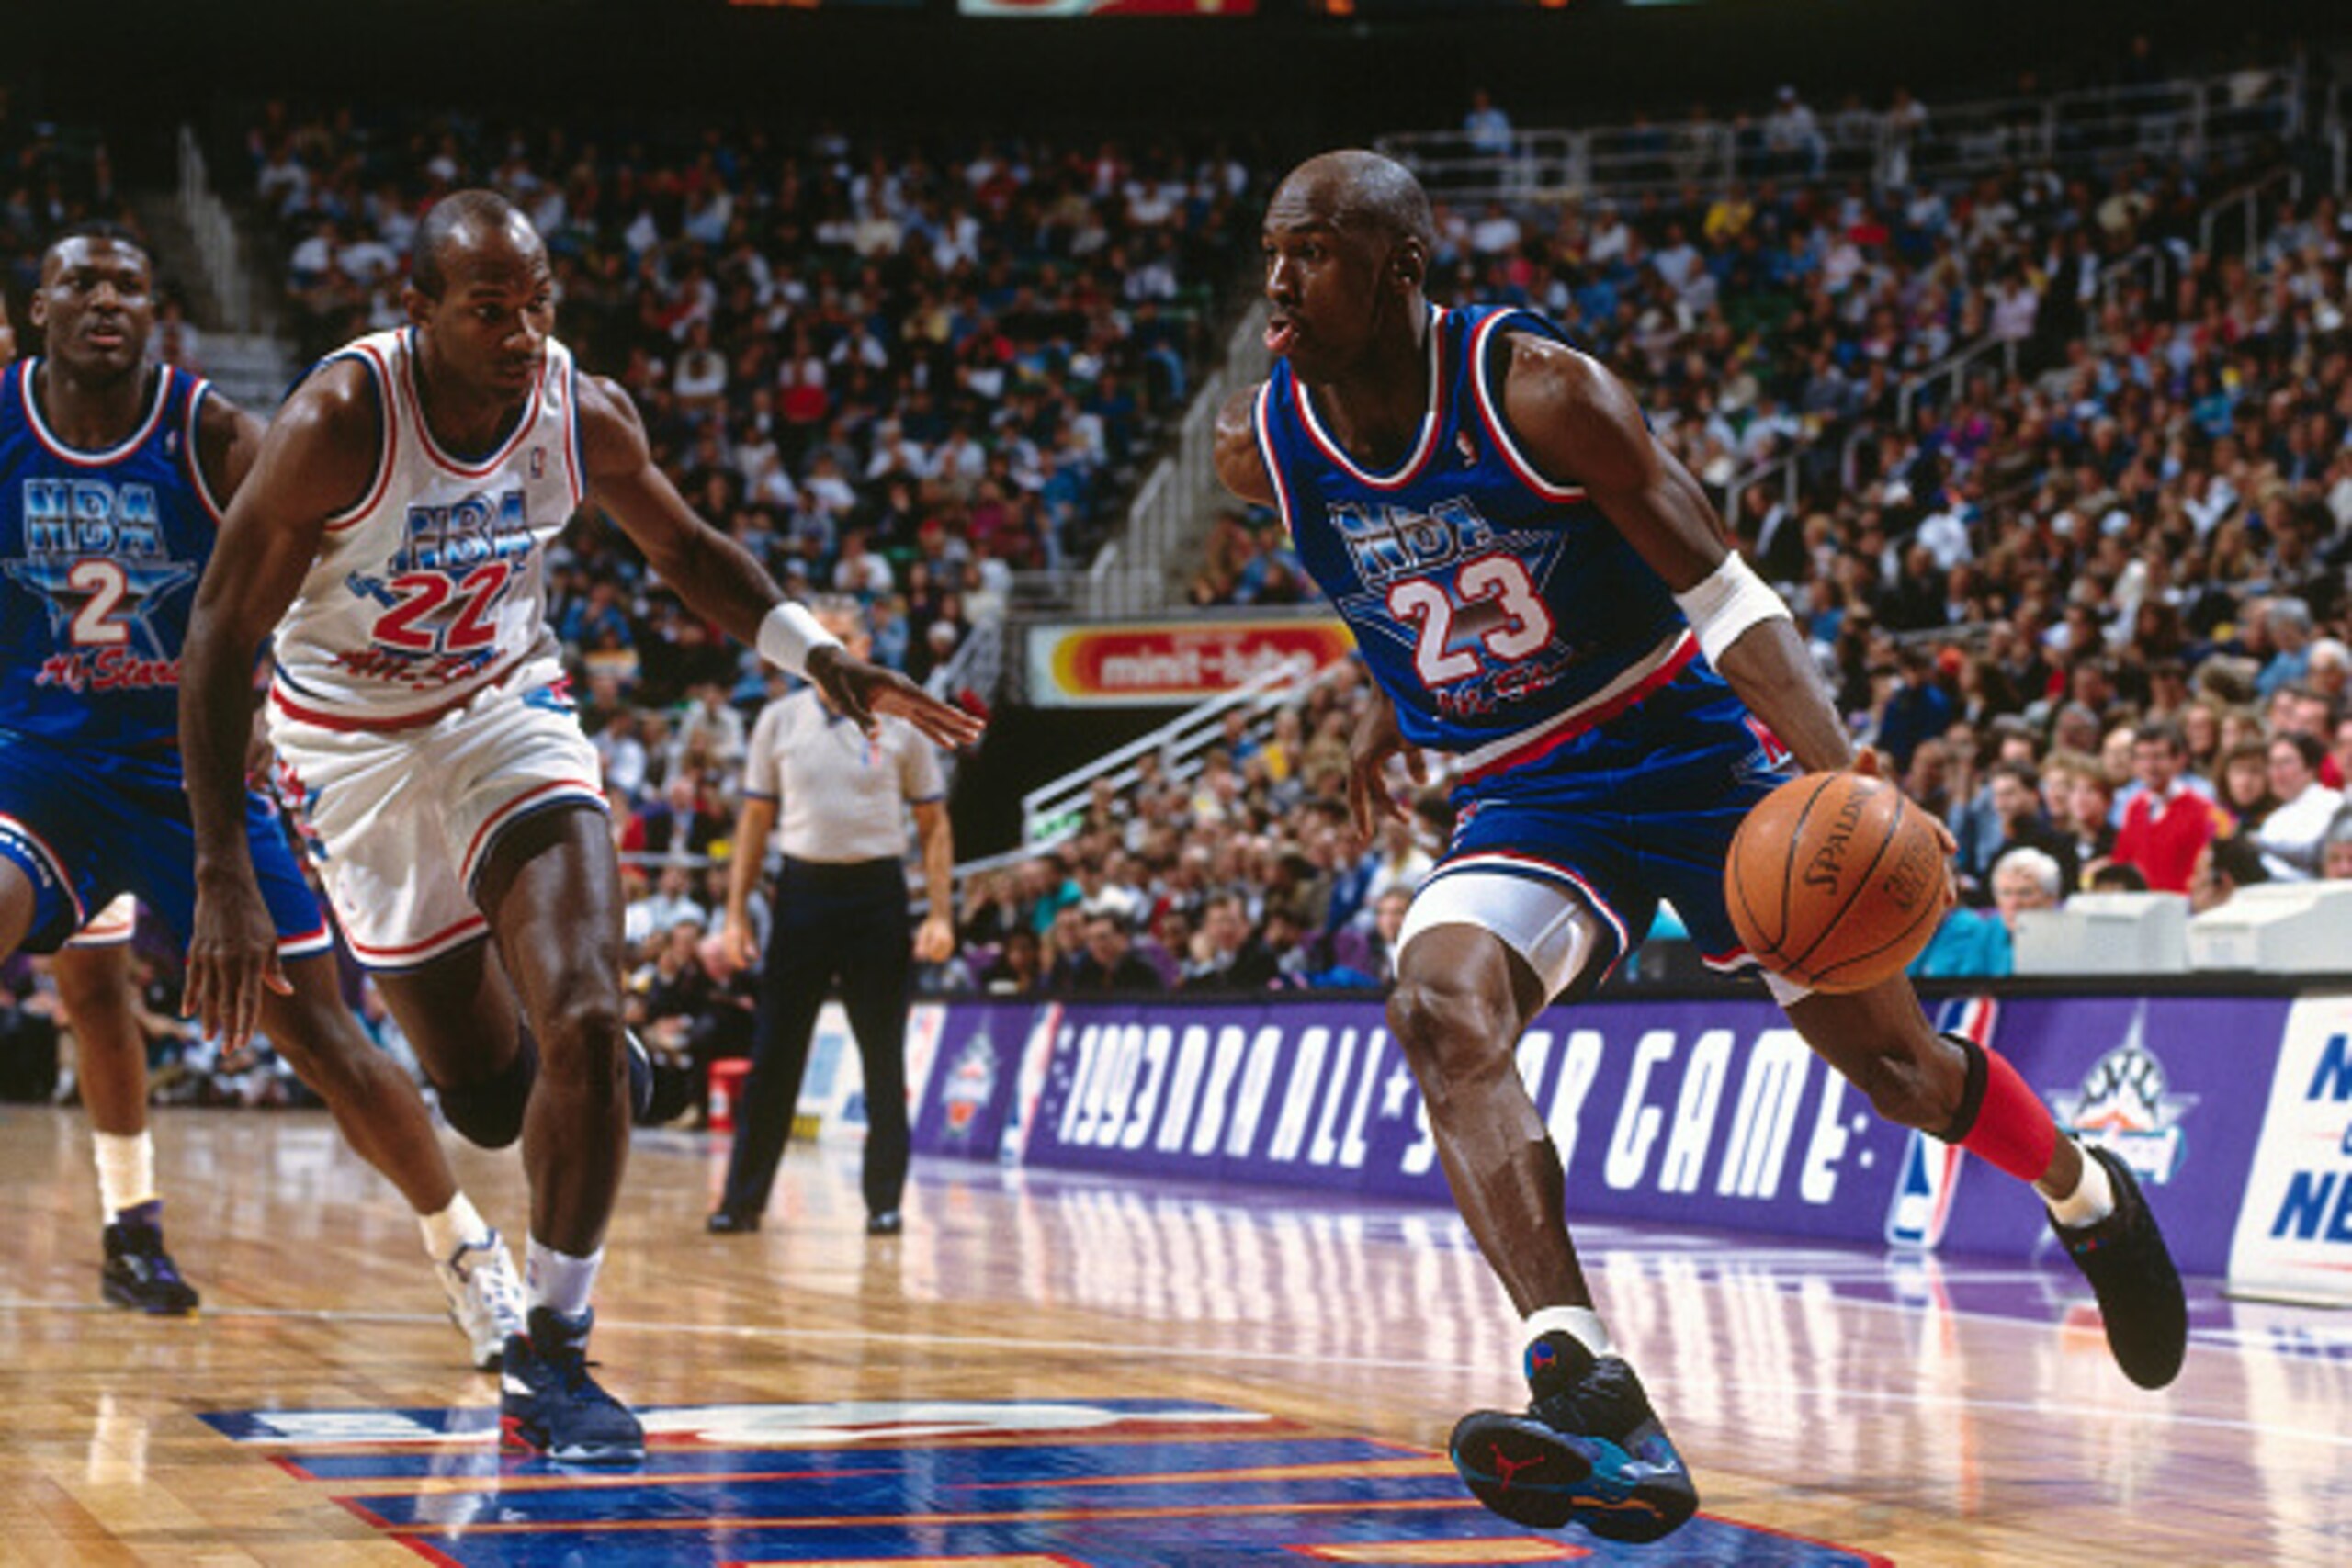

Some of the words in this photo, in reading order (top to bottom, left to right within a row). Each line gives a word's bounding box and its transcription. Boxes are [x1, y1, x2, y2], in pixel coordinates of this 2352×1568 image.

[23, 478, 170, 561] NBA
[386, 491, 536, 574] NBA
[1326, 494, 1494, 592] NBA
[68, 557, 130, 647] 2
[370, 560, 511, 653] 22
[1384, 551, 1555, 689] 23
[1058, 1024, 1172, 1149] 1993
[1156, 1025, 1283, 1158] NBA
[1268, 1026, 1387, 1168] ALL
[1605, 1029, 1849, 1203] GAME
